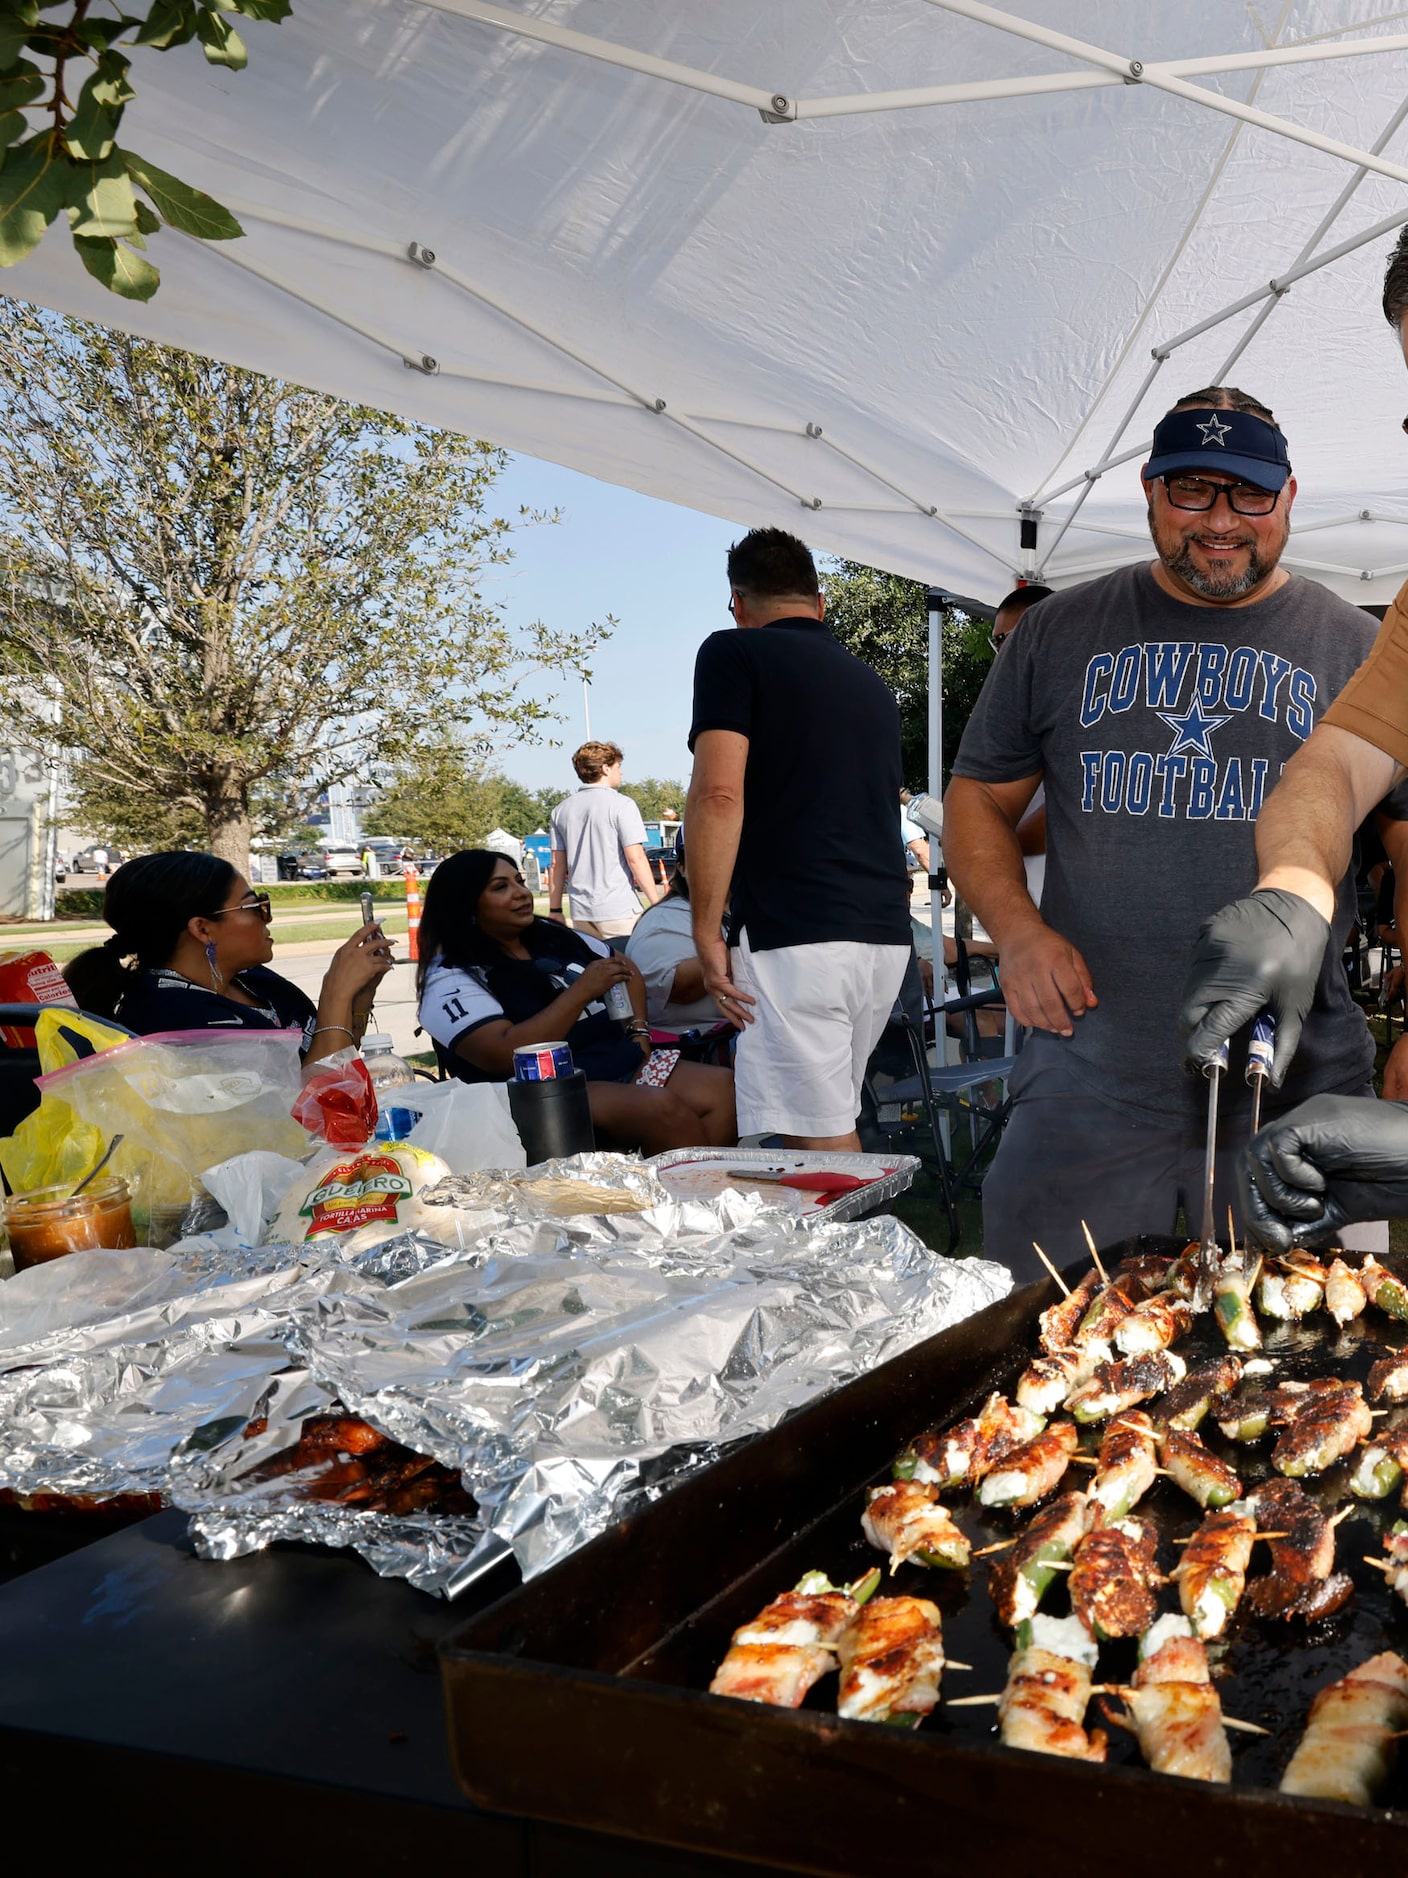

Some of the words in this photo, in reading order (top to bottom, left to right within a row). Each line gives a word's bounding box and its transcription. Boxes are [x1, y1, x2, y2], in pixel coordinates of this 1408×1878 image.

[1079, 642, 1317, 742] COWBOYS
[1080, 750, 1287, 822] FOOTBAL
[39, 989, 71, 1001] Calories
[611, 985, 625, 1009] ULTR
[442, 998, 469, 1024] 11
[320, 1211, 355, 1222] TORTILLA
